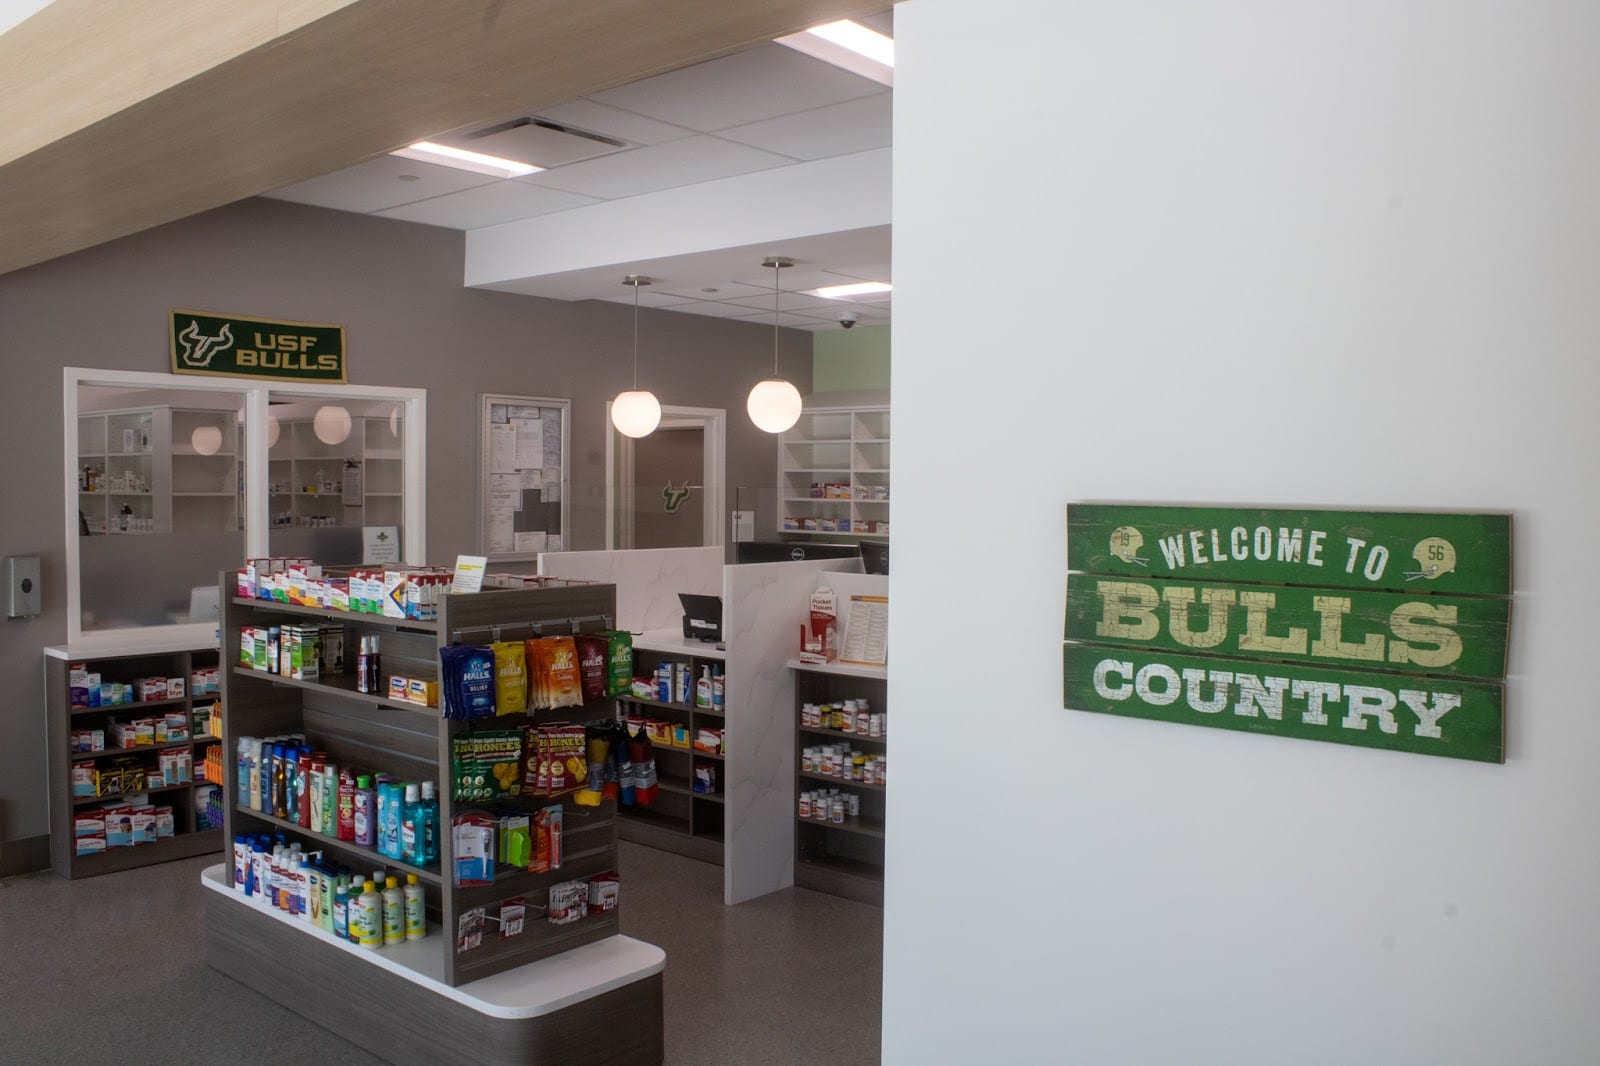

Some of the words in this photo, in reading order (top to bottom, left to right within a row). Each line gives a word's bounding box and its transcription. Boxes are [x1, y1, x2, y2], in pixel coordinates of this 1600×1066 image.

[254, 332, 317, 352] USF
[236, 349, 338, 371] BULLS
[1120, 532, 1130, 547] 19
[1158, 525, 1329, 570] WELCOME
[1345, 536, 1390, 582] TO
[1427, 545, 1445, 561] 56
[1095, 580, 1464, 668] BULLS
[551, 661, 573, 671] HALLS
[611, 654, 632, 664] HALLS
[464, 670, 490, 681] HALLS
[1092, 658, 1462, 739] COUNTRY
[475, 741, 521, 753] HONEES
